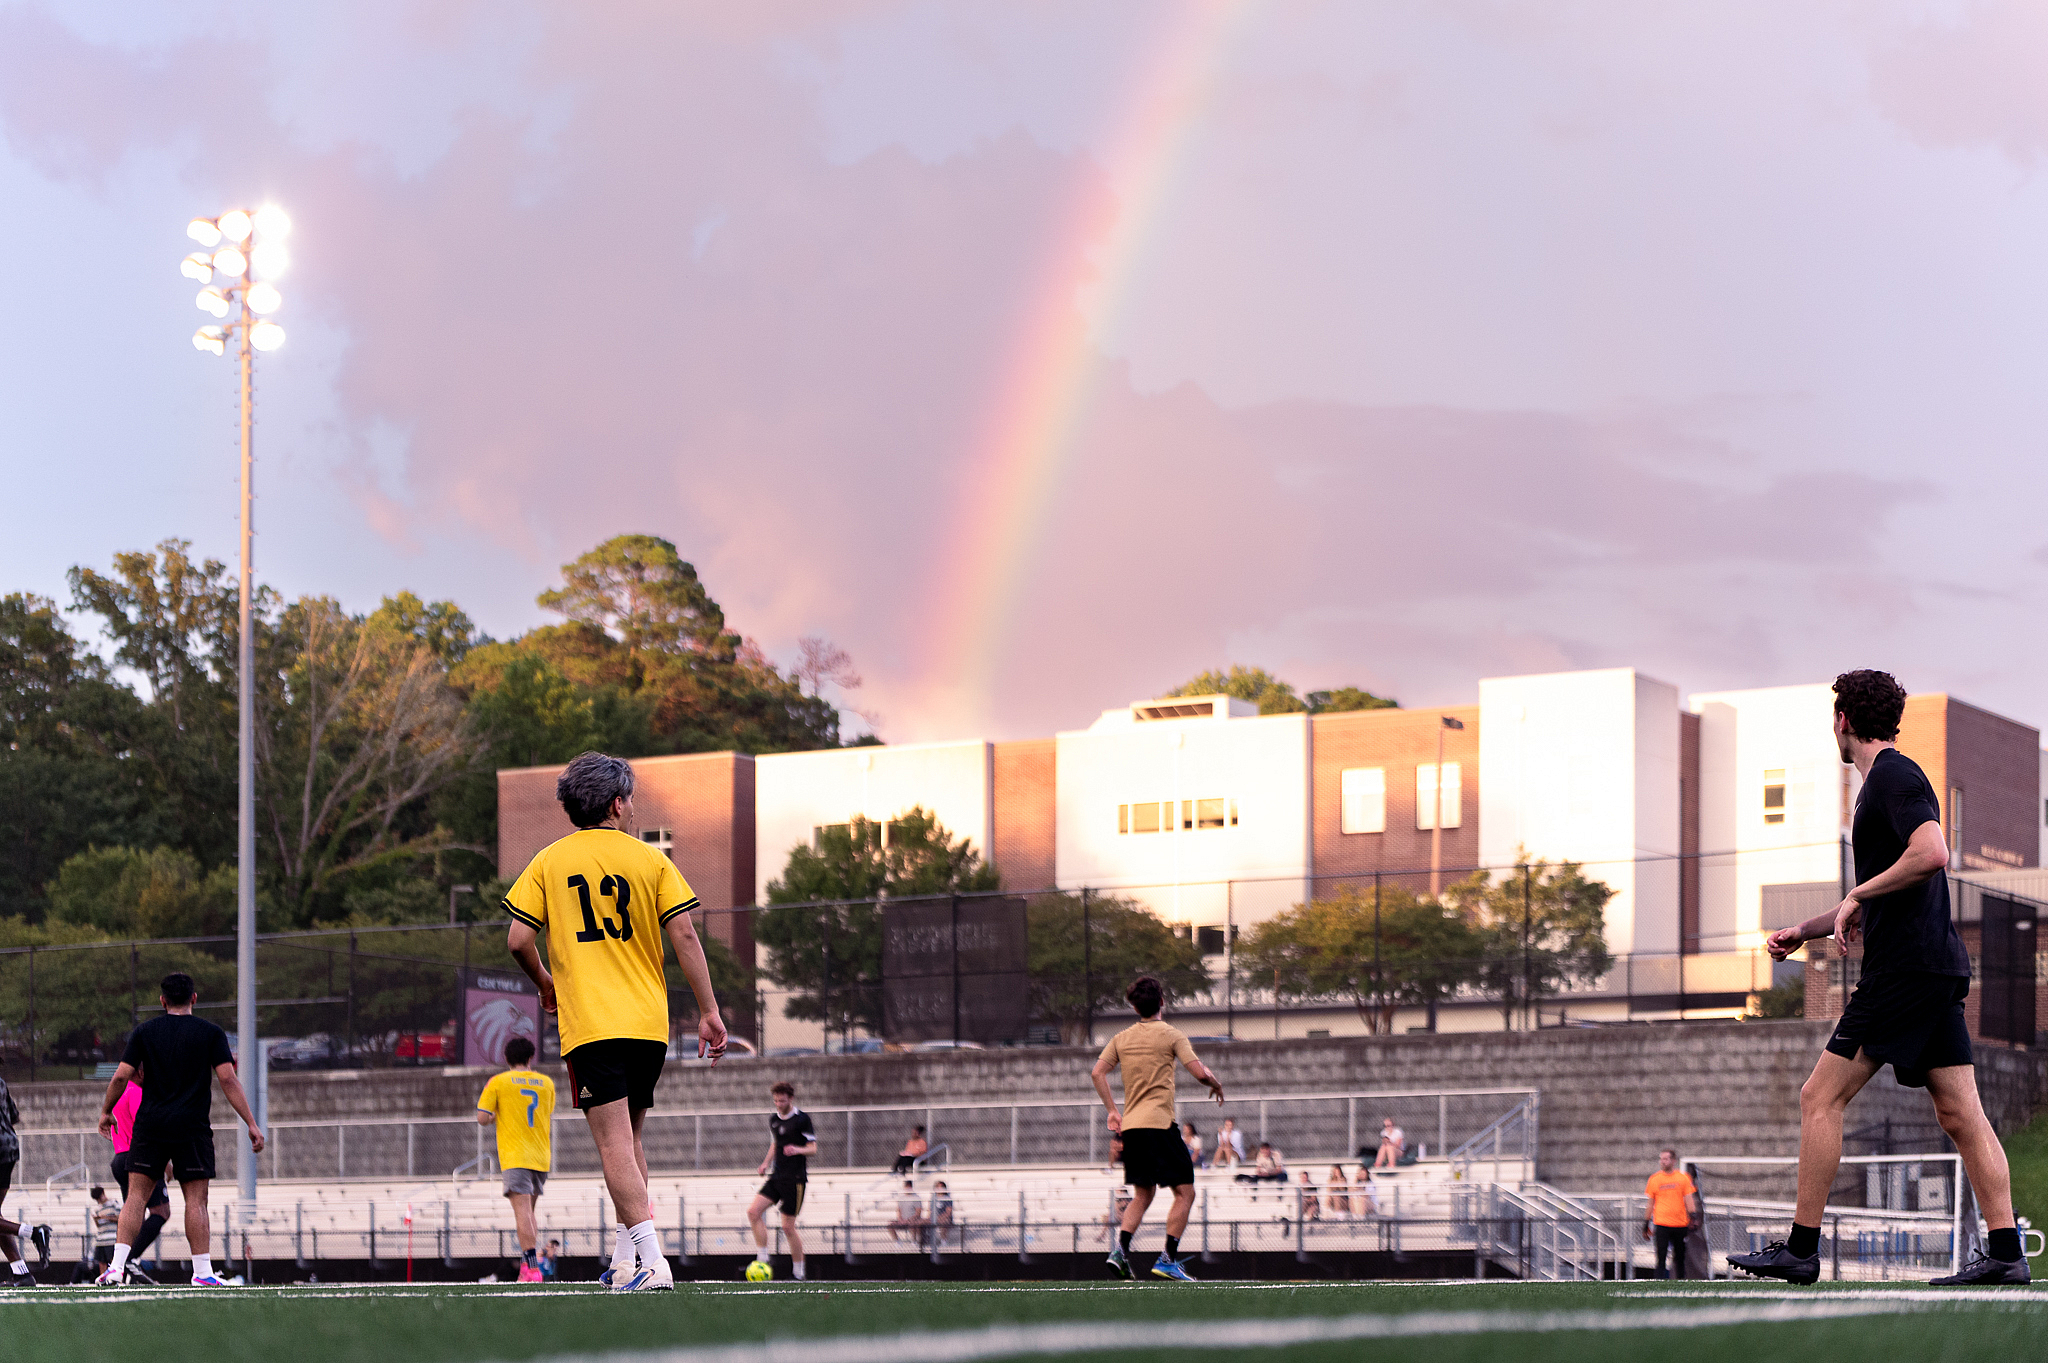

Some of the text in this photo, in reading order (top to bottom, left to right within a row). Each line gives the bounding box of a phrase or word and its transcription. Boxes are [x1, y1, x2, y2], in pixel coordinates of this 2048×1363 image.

[567, 873, 634, 942] 13
[511, 1077, 527, 1085] LUIS
[520, 1088, 539, 1128] 7
